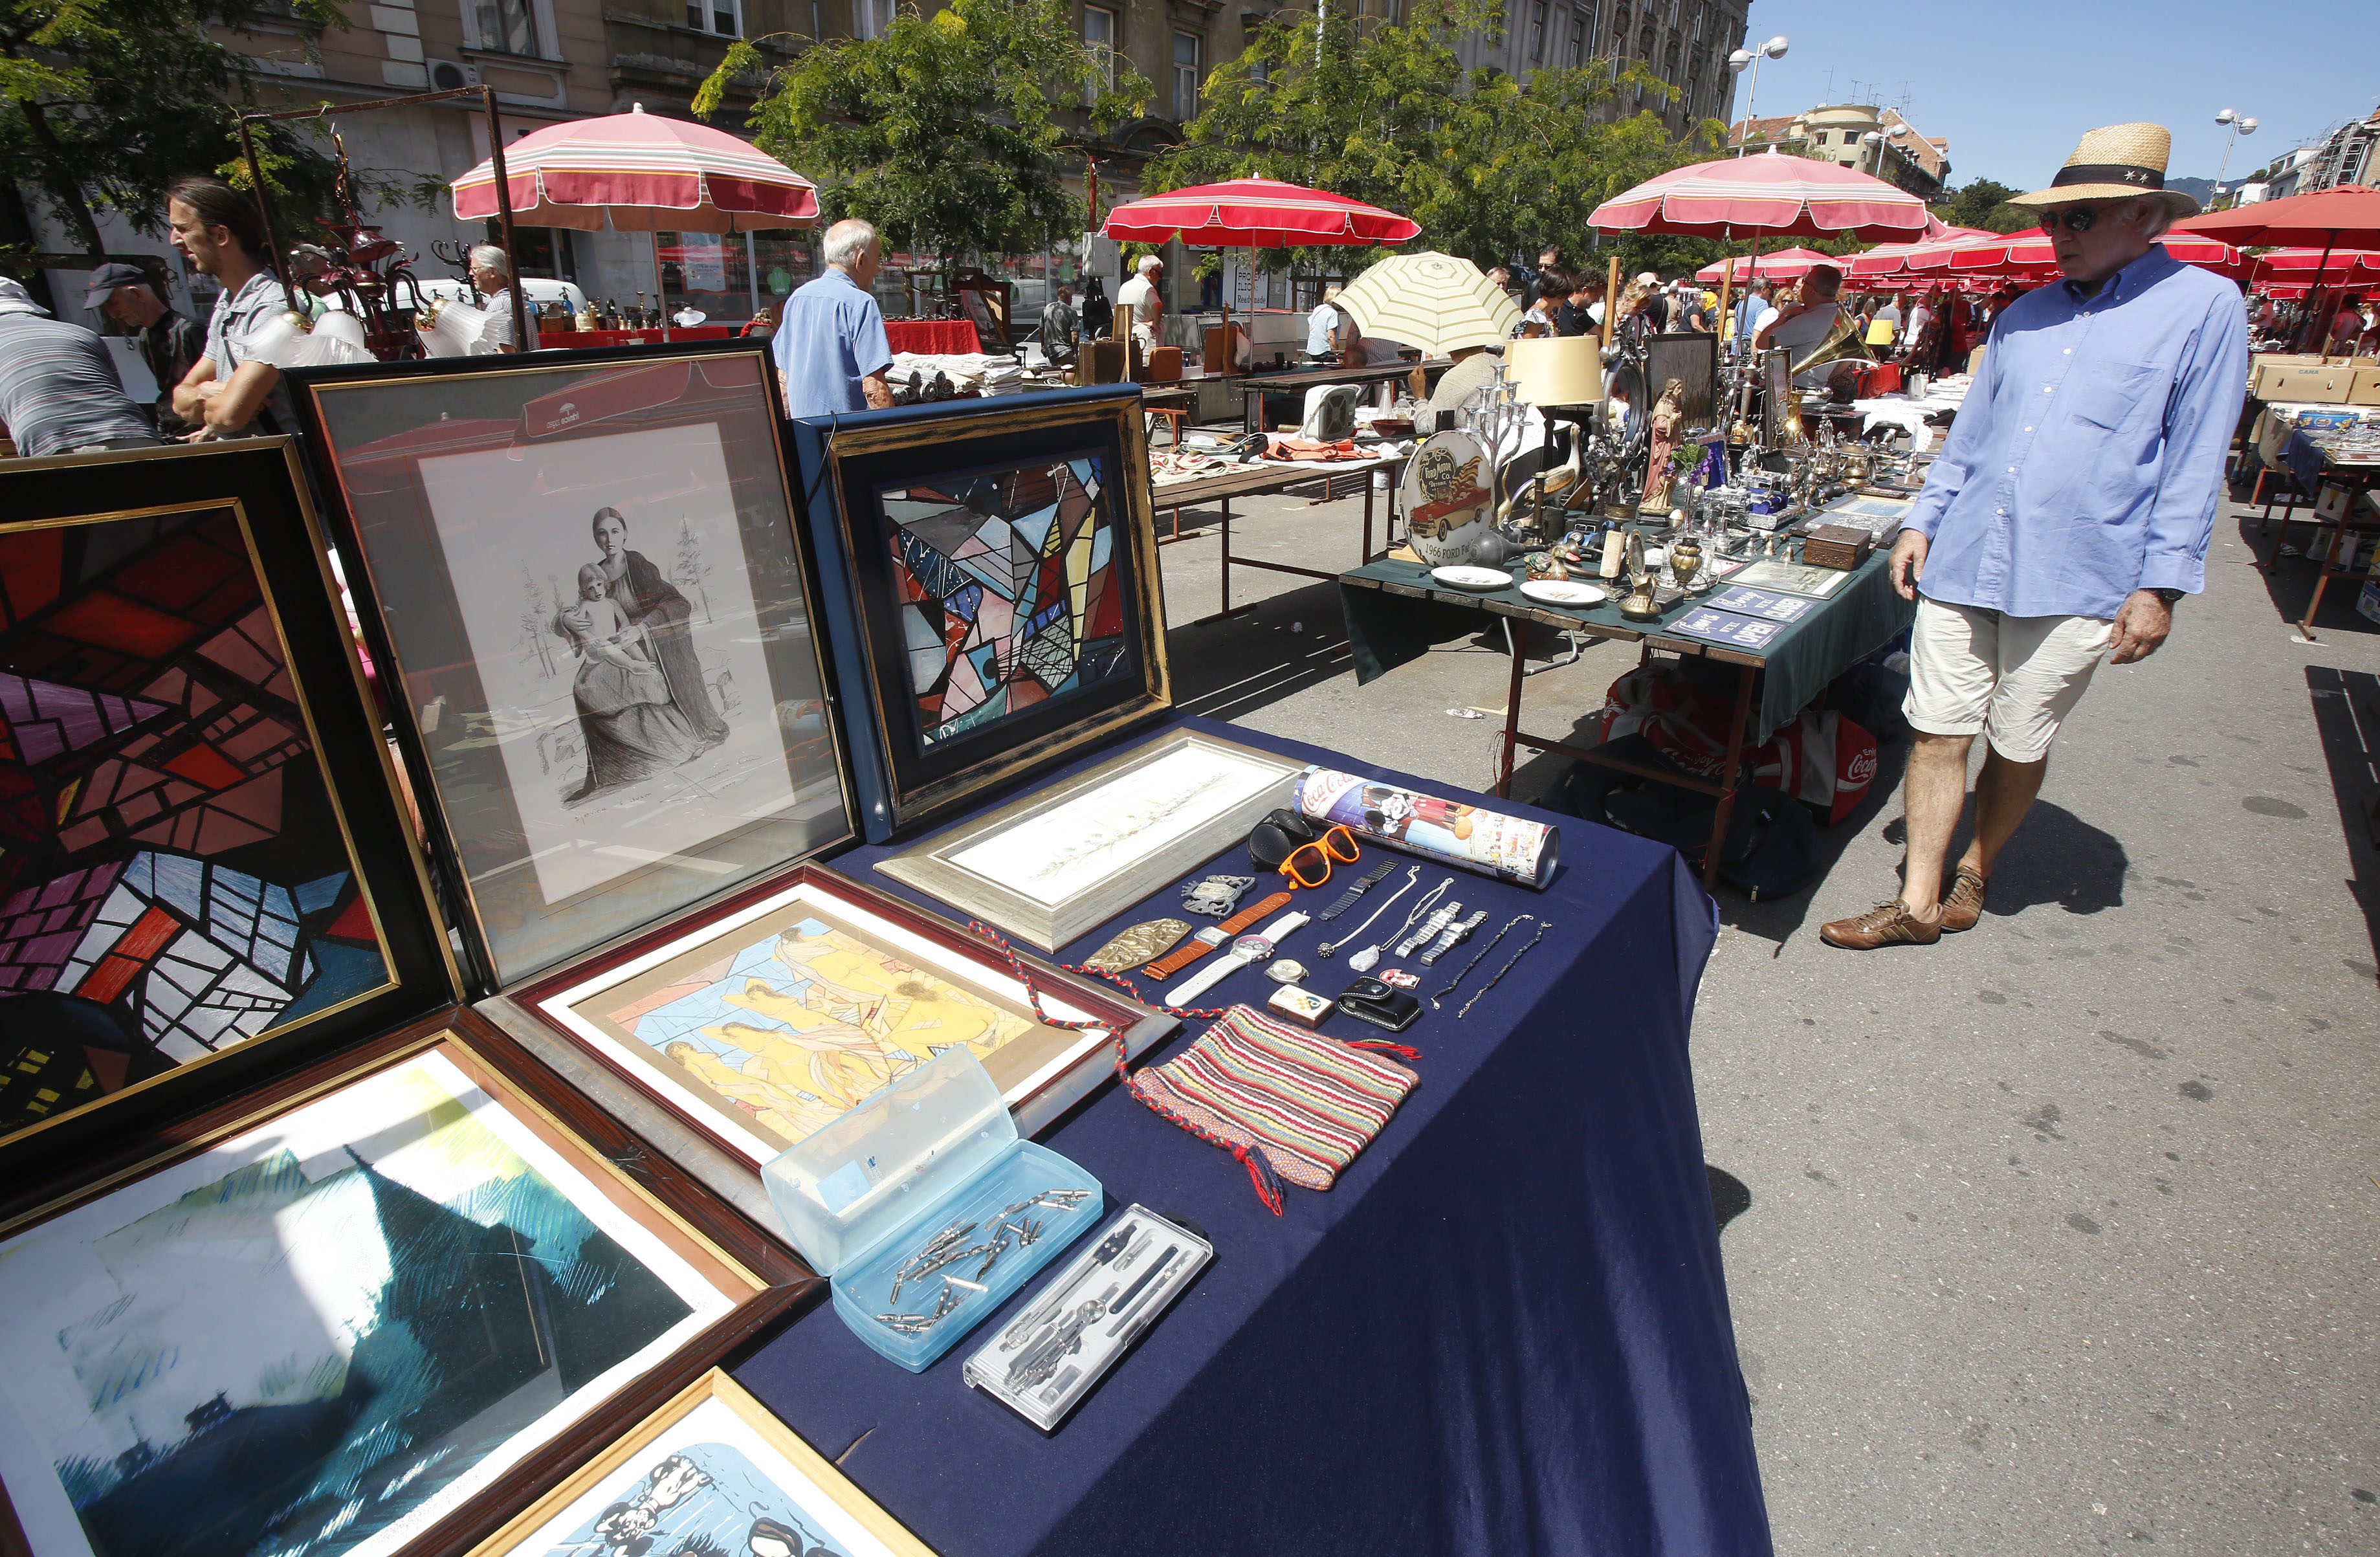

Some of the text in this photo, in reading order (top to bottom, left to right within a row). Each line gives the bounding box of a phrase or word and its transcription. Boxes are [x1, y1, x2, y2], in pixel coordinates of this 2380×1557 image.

[1238, 272, 1266, 281] PROEKT
[1426, 543, 1441, 558] 1966
[1442, 547, 1460, 559] FORD
[1763, 597, 1807, 619] CLOSED
[1732, 621, 1778, 643] OPEN
